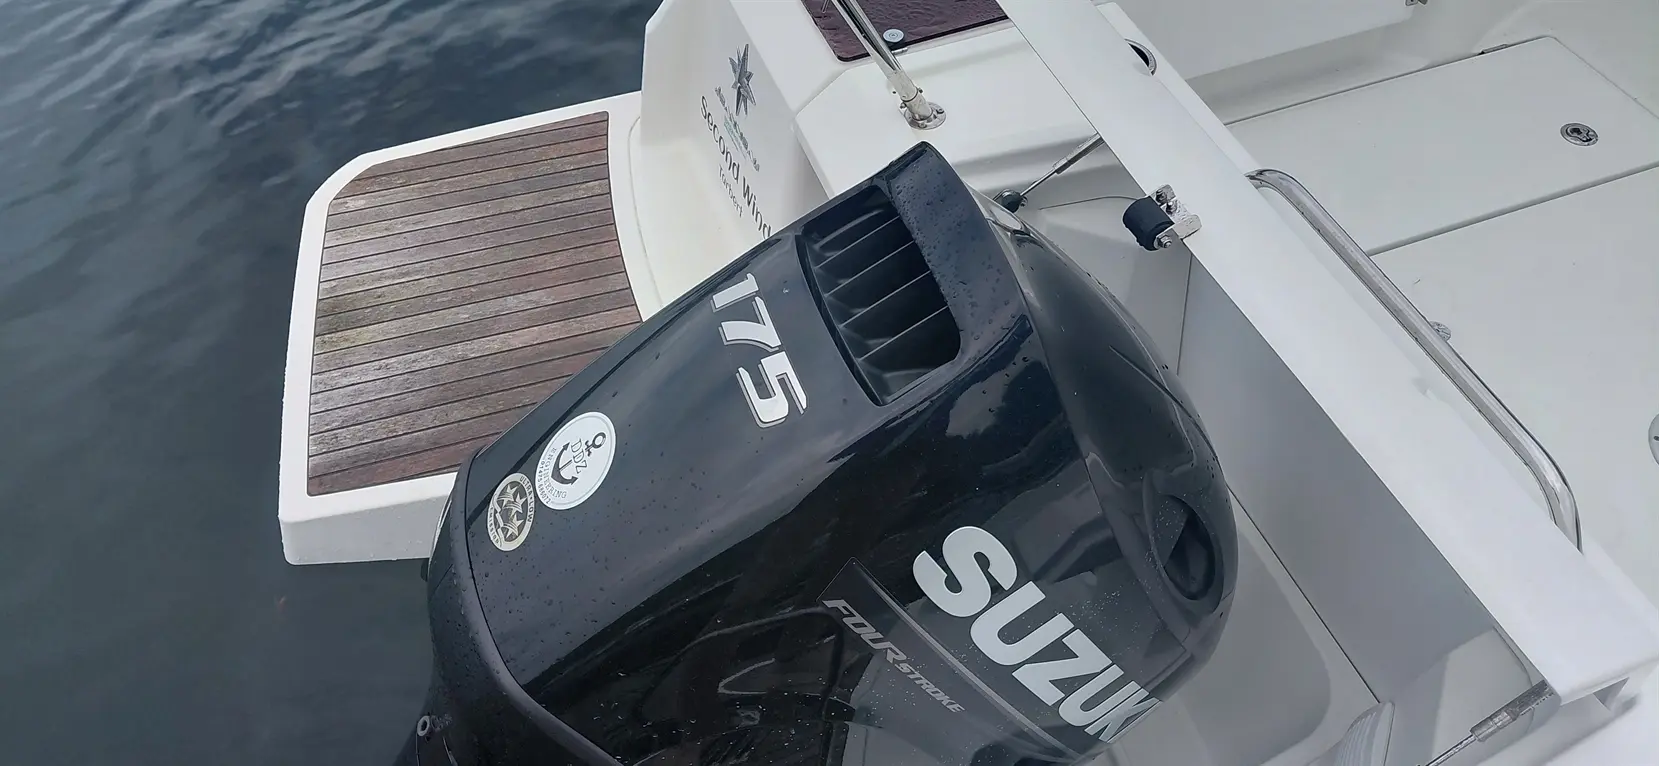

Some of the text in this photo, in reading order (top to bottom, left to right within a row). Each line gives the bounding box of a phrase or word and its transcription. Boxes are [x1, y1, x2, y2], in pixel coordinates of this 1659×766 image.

[701, 95, 740, 184] Second
[742, 176, 771, 239] Wind
[711, 273, 807, 428] 175
[543, 447, 567, 499] ENGINEERING
[571, 438, 588, 474] DDZ
[822, 599, 966, 713] FOUR STROKE
[912, 525, 1163, 743] SUZUK
